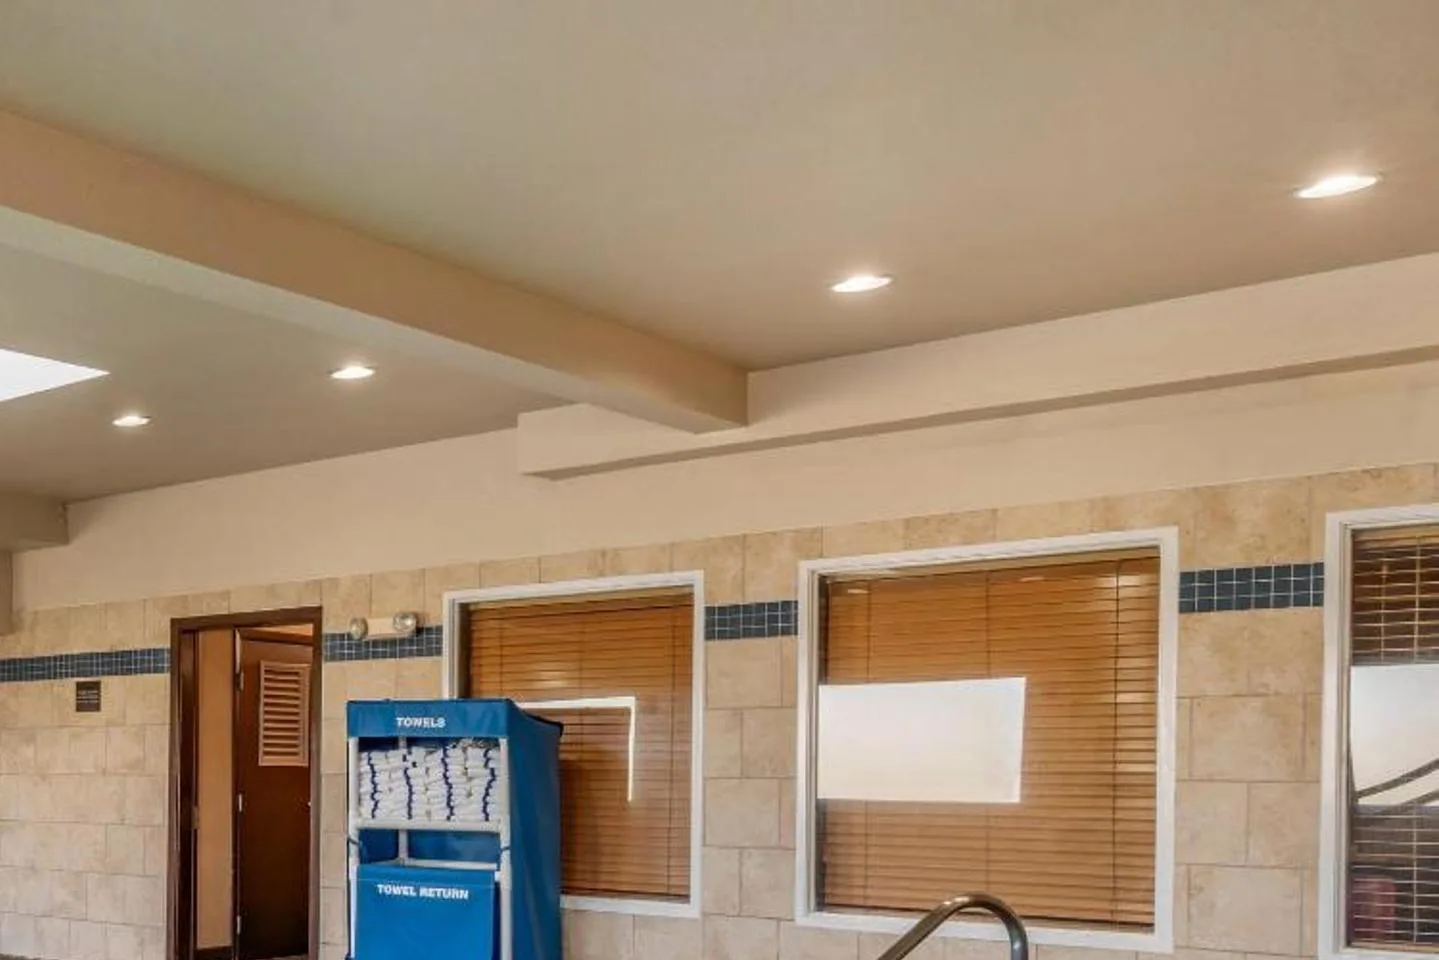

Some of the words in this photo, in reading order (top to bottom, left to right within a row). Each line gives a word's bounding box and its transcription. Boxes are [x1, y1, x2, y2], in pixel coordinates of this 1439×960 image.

[396, 717, 446, 728] TOWELS
[377, 884, 417, 897] TOWEL
[420, 887, 469, 900] RETURN
